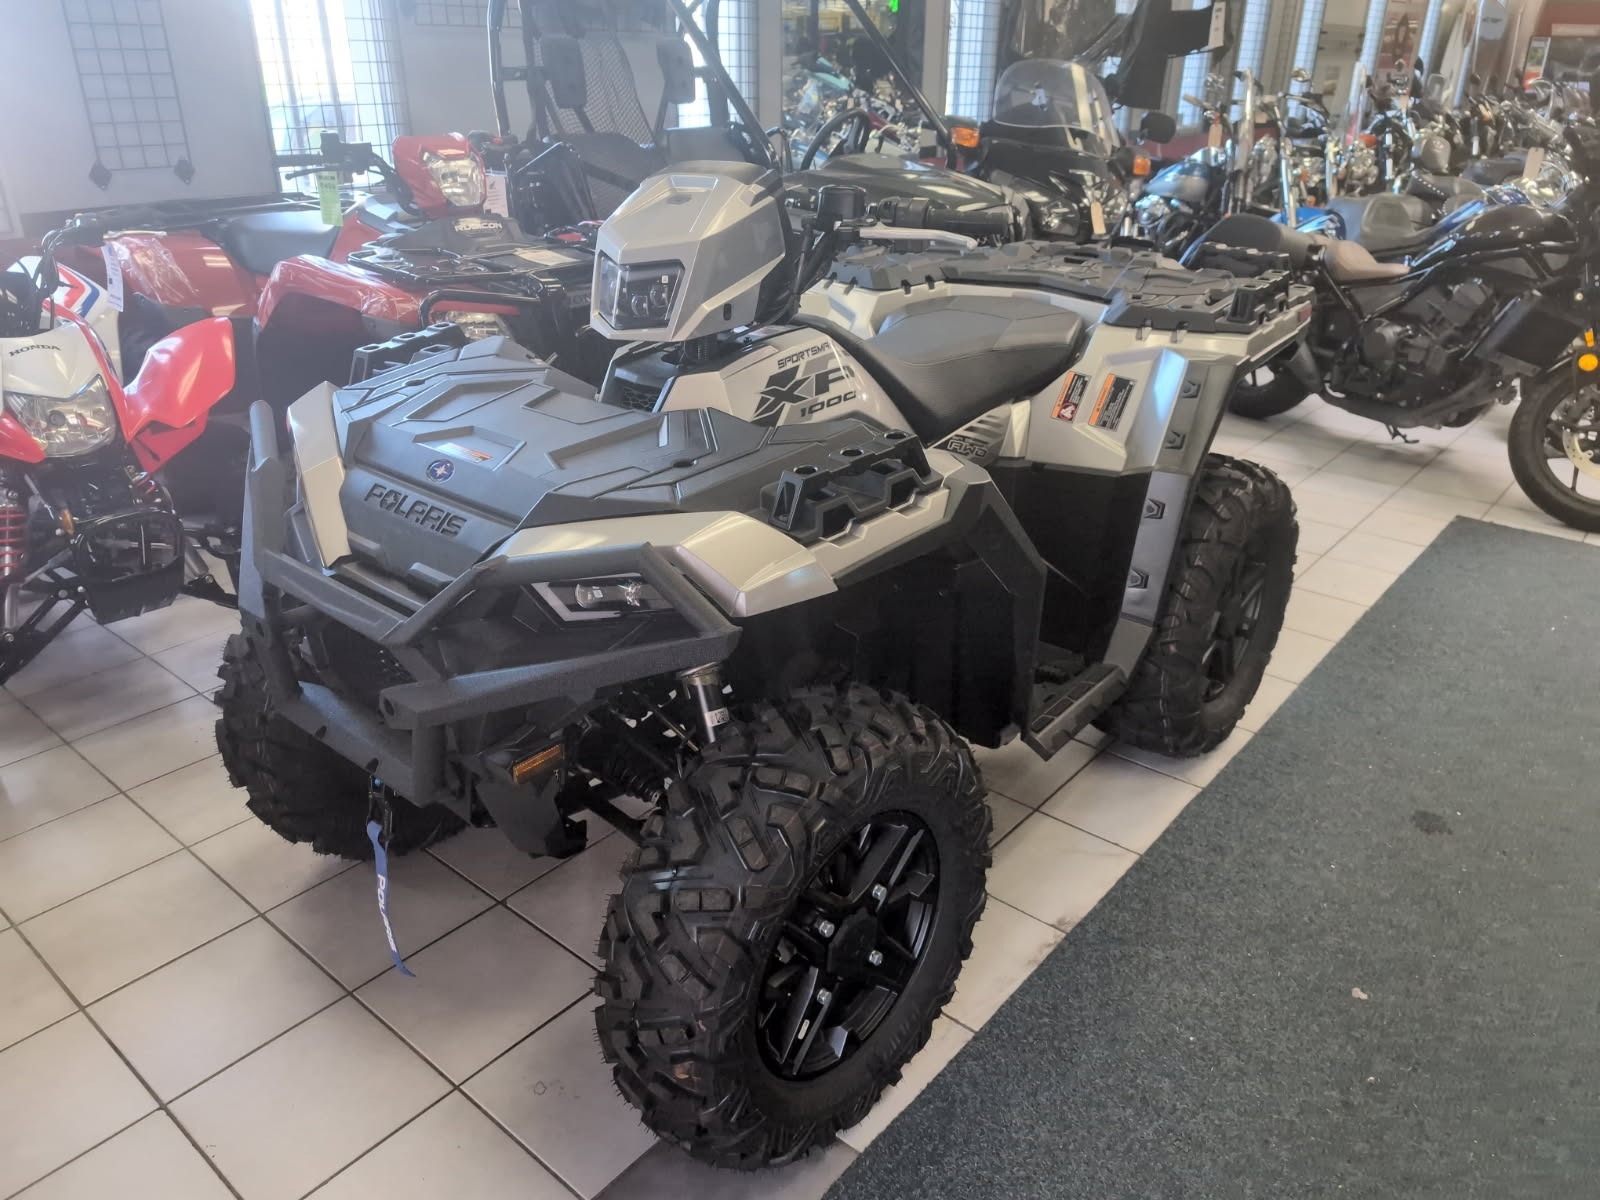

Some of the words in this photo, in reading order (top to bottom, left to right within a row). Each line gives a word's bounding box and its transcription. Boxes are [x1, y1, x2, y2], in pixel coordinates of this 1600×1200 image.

[455, 222, 502, 232] RUBICON
[8, 344, 62, 356] HONDA
[777, 342, 831, 369] SPORTSMA
[363, 482, 468, 537] POLARIS
